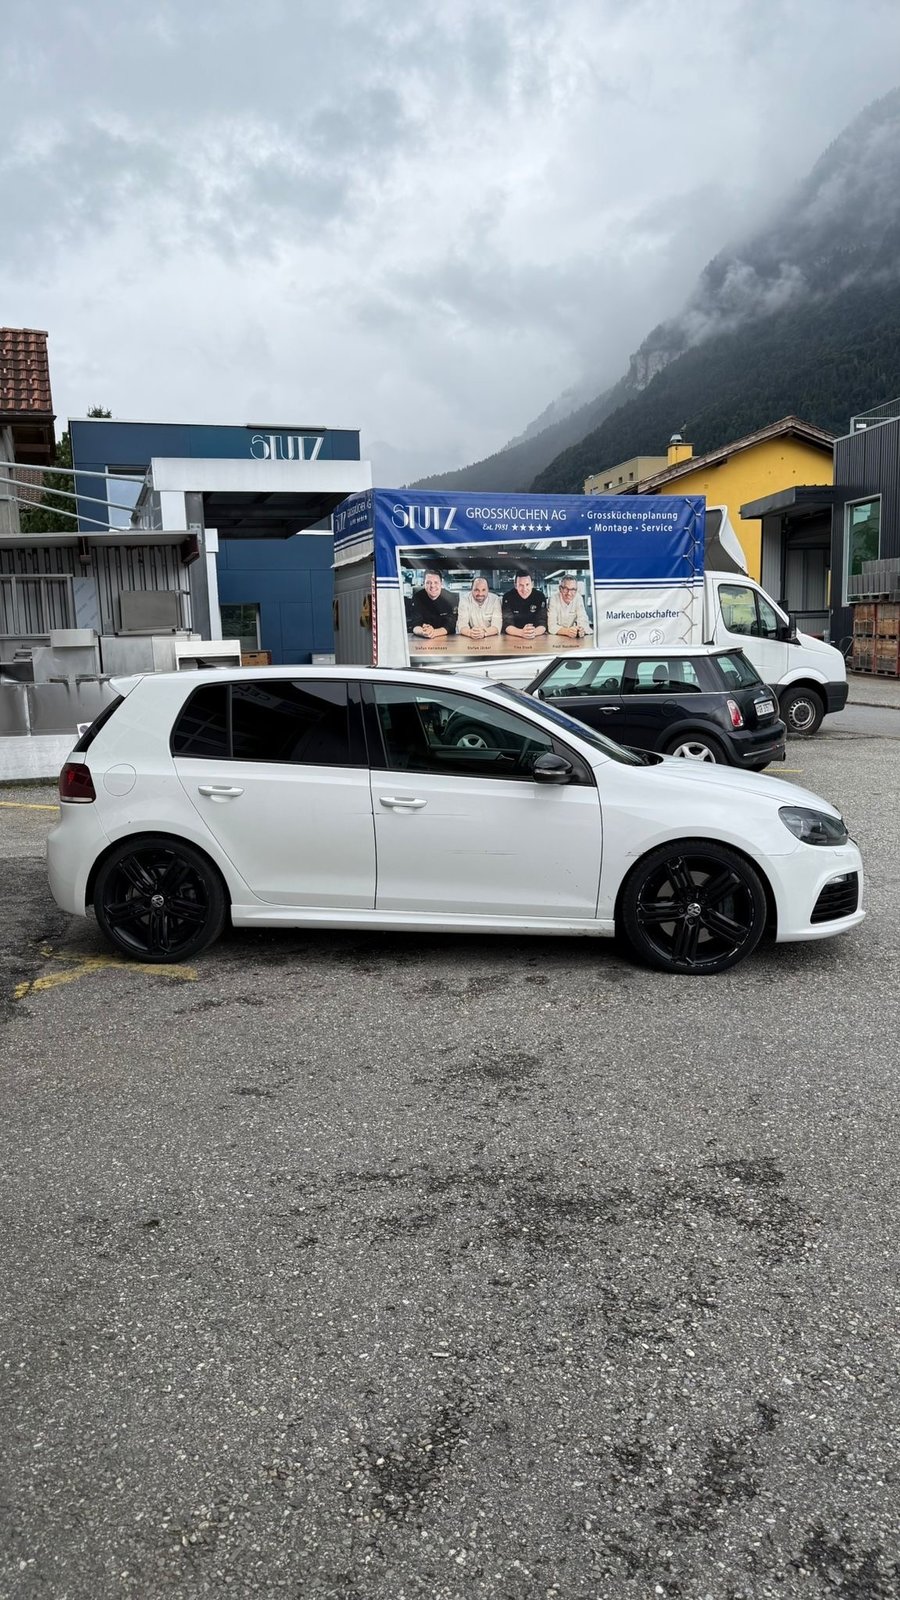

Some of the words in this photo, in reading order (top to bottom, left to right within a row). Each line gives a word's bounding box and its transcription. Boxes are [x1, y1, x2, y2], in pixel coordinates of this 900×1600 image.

[250, 434, 325, 460] STUTZ
[391, 503, 458, 531] STUTZ
[465, 506, 548, 520] GROSSKÜCHEN
[551, 509, 567, 521] AG
[586, 510, 678, 521] Grossküchenplanung
[482, 523, 494, 531] Est.
[495, 523, 508, 531] 1981
[594, 523, 633, 534] Montage
[641, 523, 673, 532] Service
[606, 608, 680, 620] Markenbotschafter
